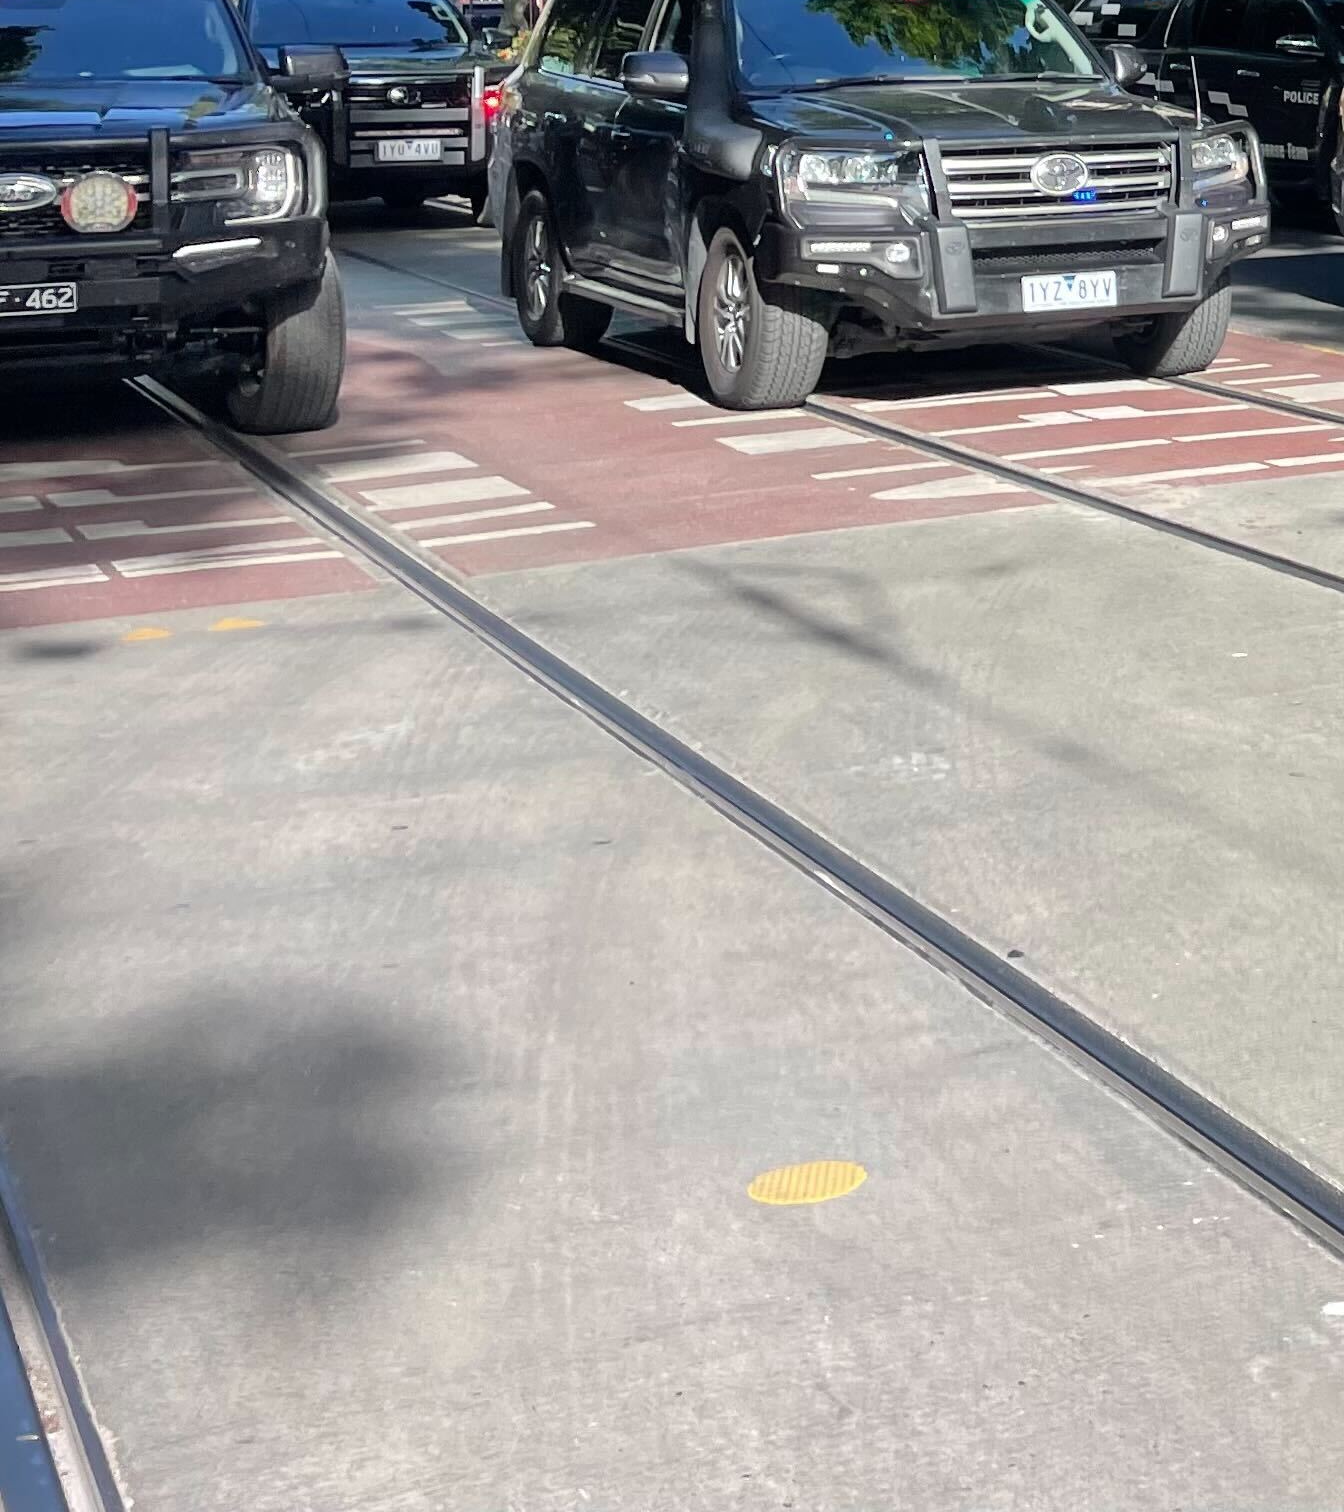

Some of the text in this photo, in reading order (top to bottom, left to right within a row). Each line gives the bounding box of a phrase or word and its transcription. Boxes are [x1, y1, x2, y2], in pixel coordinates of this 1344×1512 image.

[1283, 90, 1320, 105] POLICE
[1030, 278, 1112, 303] 1YZ 8YV
